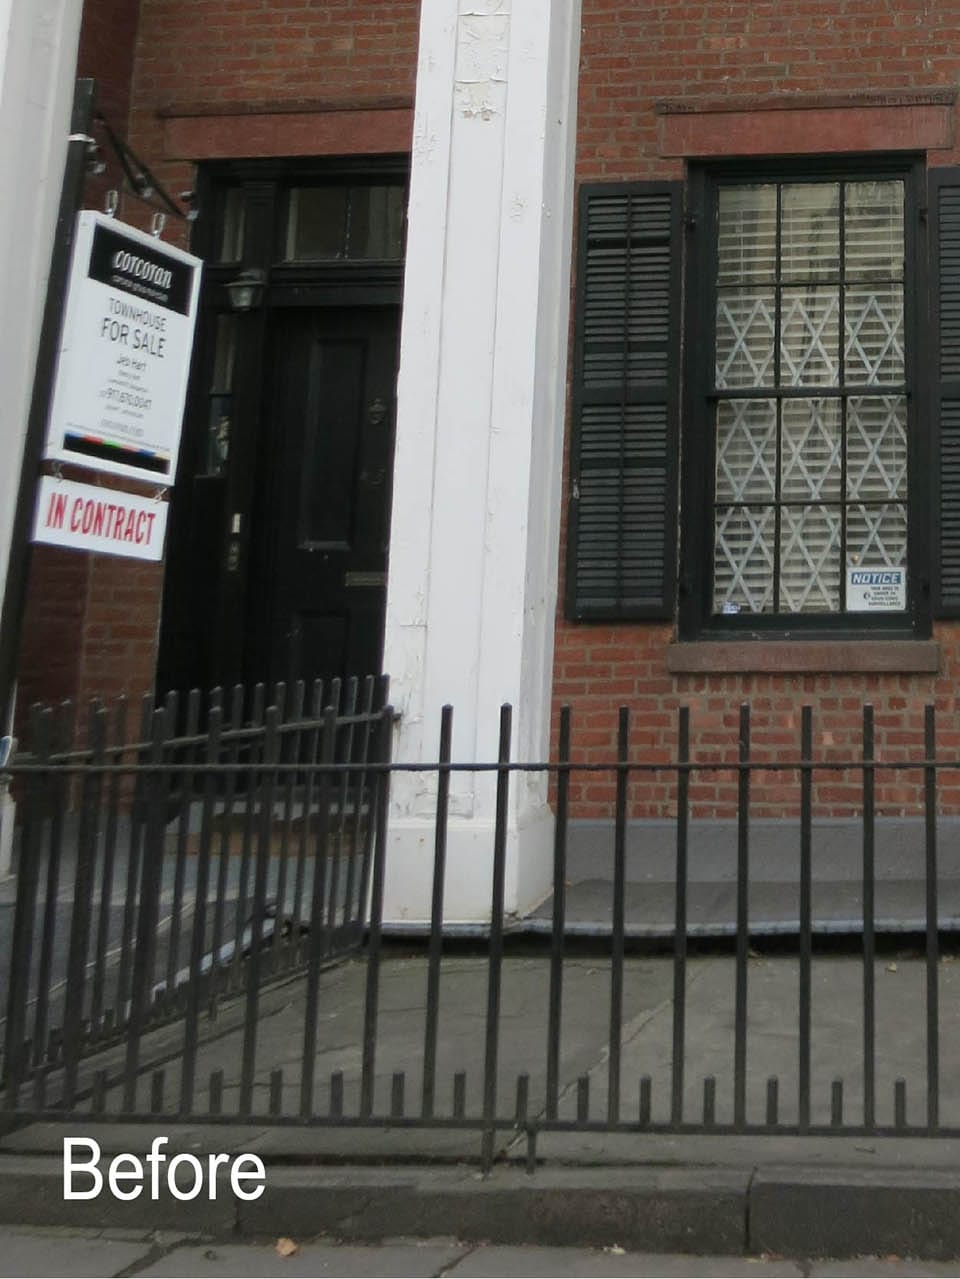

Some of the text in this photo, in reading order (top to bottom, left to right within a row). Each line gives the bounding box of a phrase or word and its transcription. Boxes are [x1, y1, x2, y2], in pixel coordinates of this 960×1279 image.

[112, 250, 173, 289] corcoran
[109, 297, 168, 332] TOWNHOUSE
[101, 317, 167, 358] FOR SALE
[45, 492, 156, 545] IN CONTRACT
[852, 573, 900, 584] NOTICE
